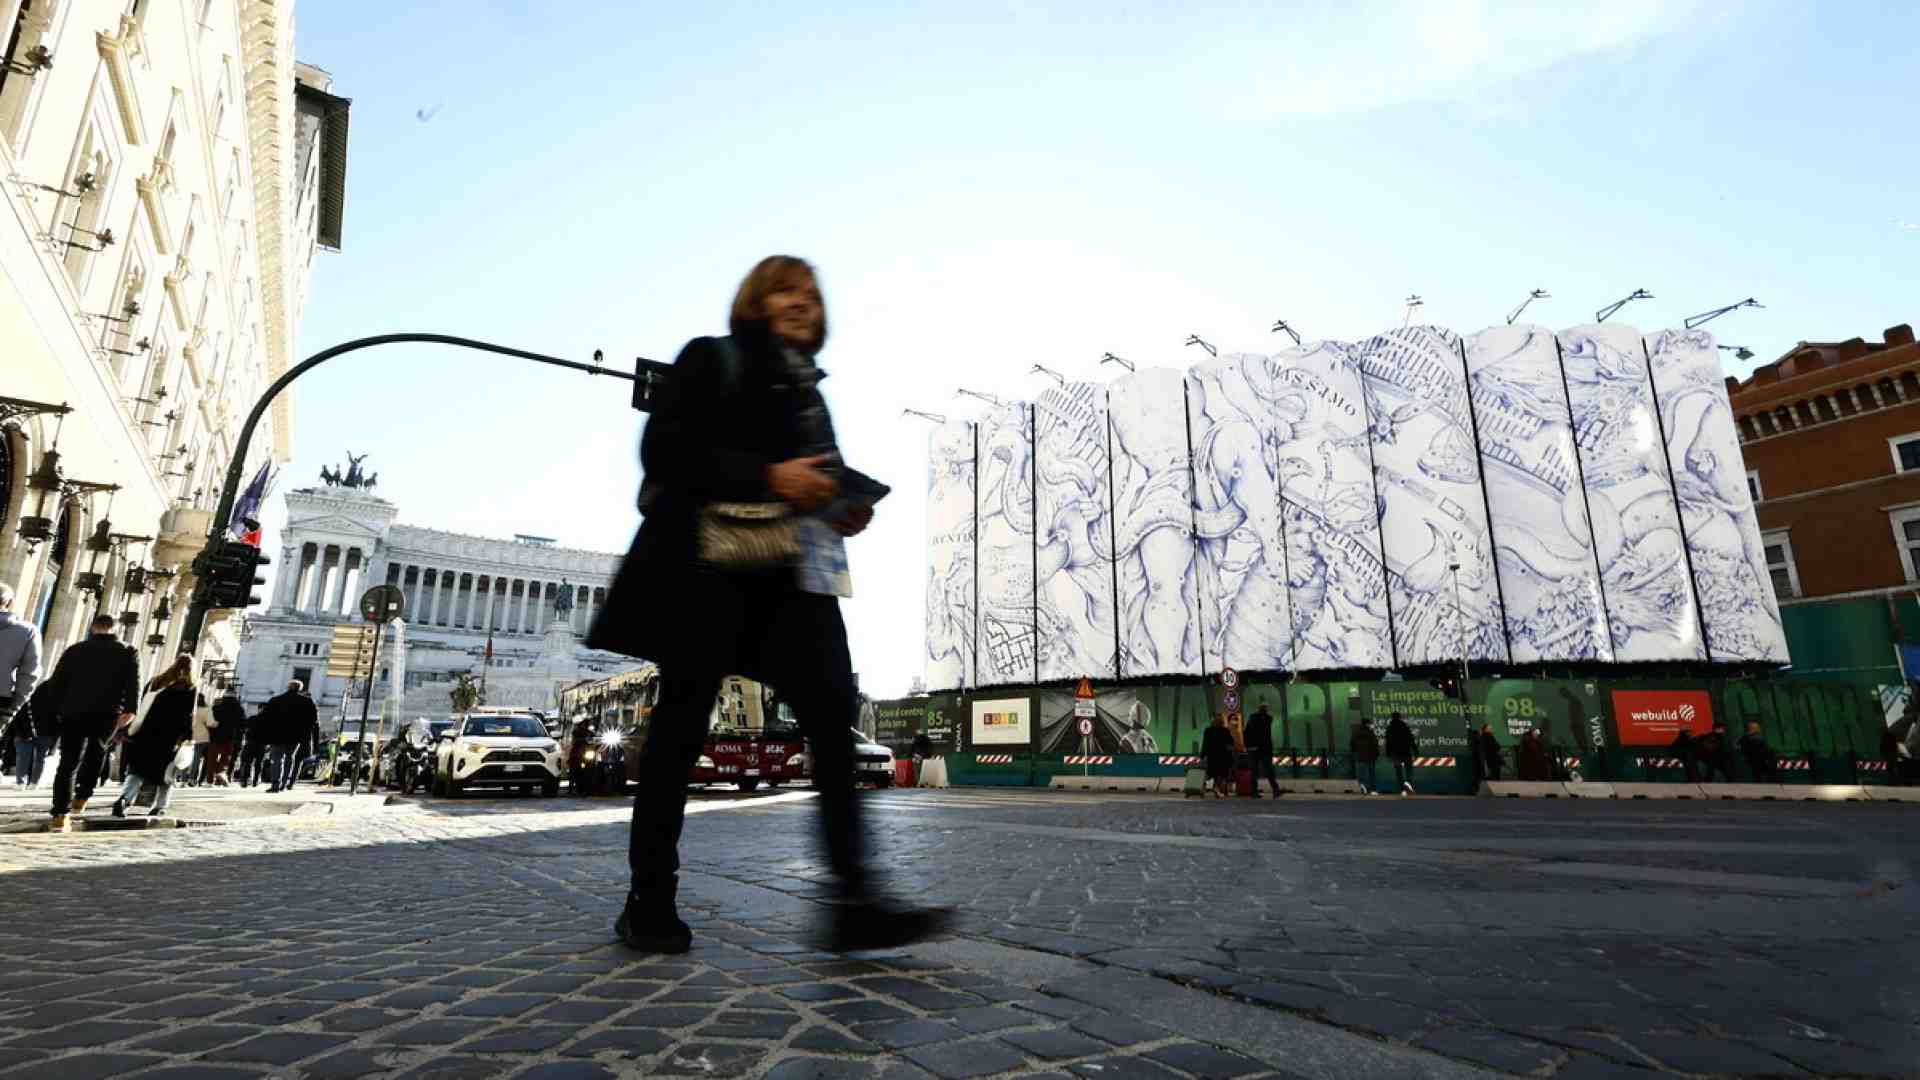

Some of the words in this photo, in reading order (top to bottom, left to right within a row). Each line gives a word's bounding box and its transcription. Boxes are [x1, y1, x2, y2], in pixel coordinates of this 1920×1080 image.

[1142, 682, 1360, 755] VAORE
[1631, 708, 1678, 720] webuild
[715, 744, 743, 753] ROMA
[765, 744, 785, 753] atac
